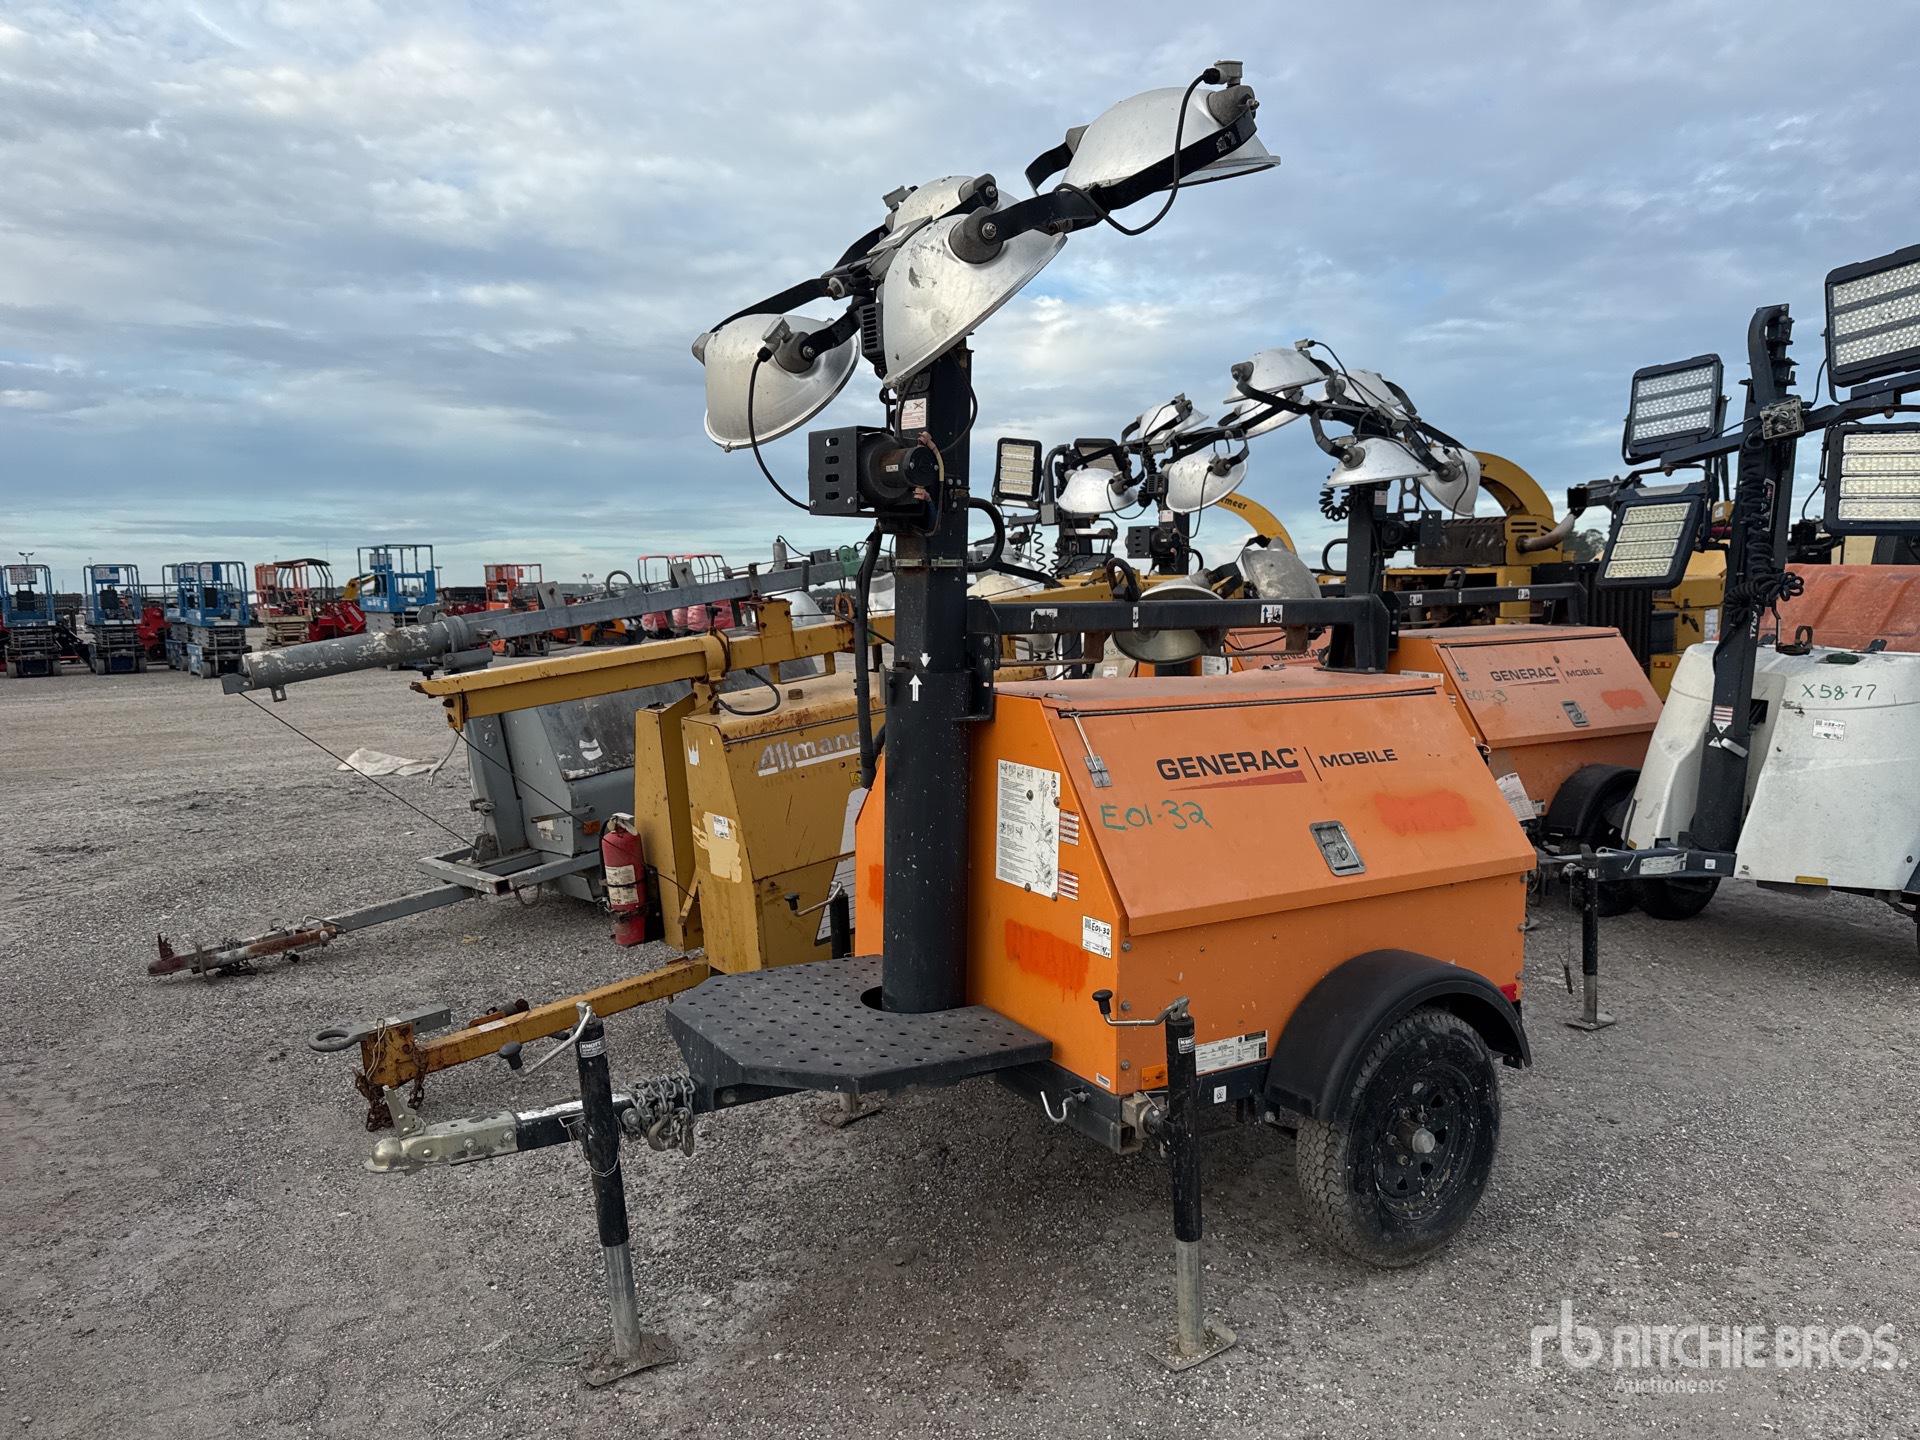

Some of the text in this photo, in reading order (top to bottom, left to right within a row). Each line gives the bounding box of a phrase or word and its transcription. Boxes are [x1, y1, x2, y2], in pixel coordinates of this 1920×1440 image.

[1490, 666, 1604, 682] GENERAC MOBILE
[1156, 747, 1399, 781] GENERAC MOBILE
